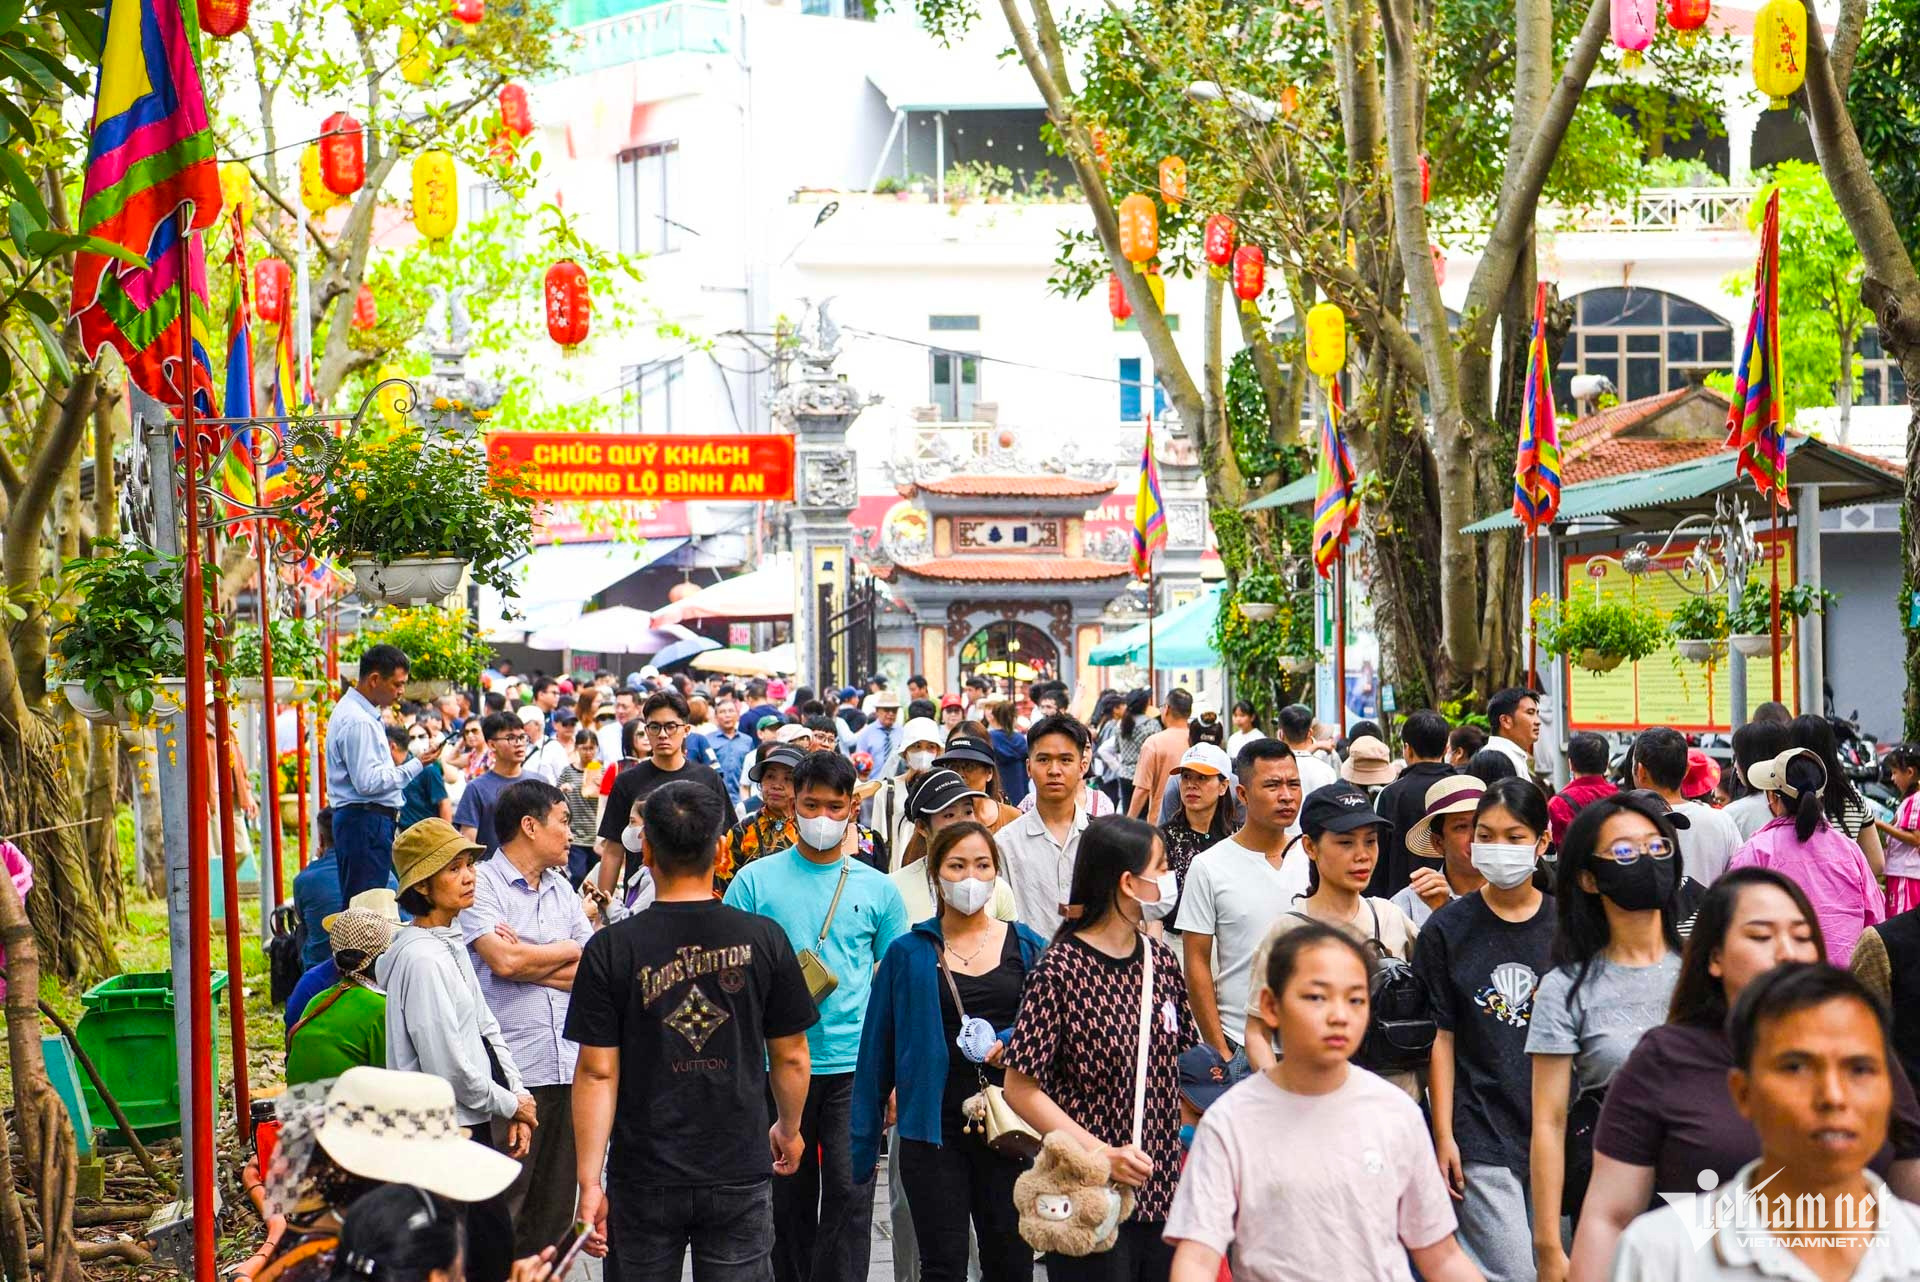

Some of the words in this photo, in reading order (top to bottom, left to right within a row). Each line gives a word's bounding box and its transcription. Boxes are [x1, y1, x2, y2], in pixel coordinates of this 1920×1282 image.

[533, 442, 602, 465] CHÚC
[608, 442, 658, 467] QUÝ
[664, 442, 749, 465] KHÁCH
[627, 469, 658, 495] LỘ
[665, 470, 724, 493] BÌNH
[730, 473, 765, 493] AN
